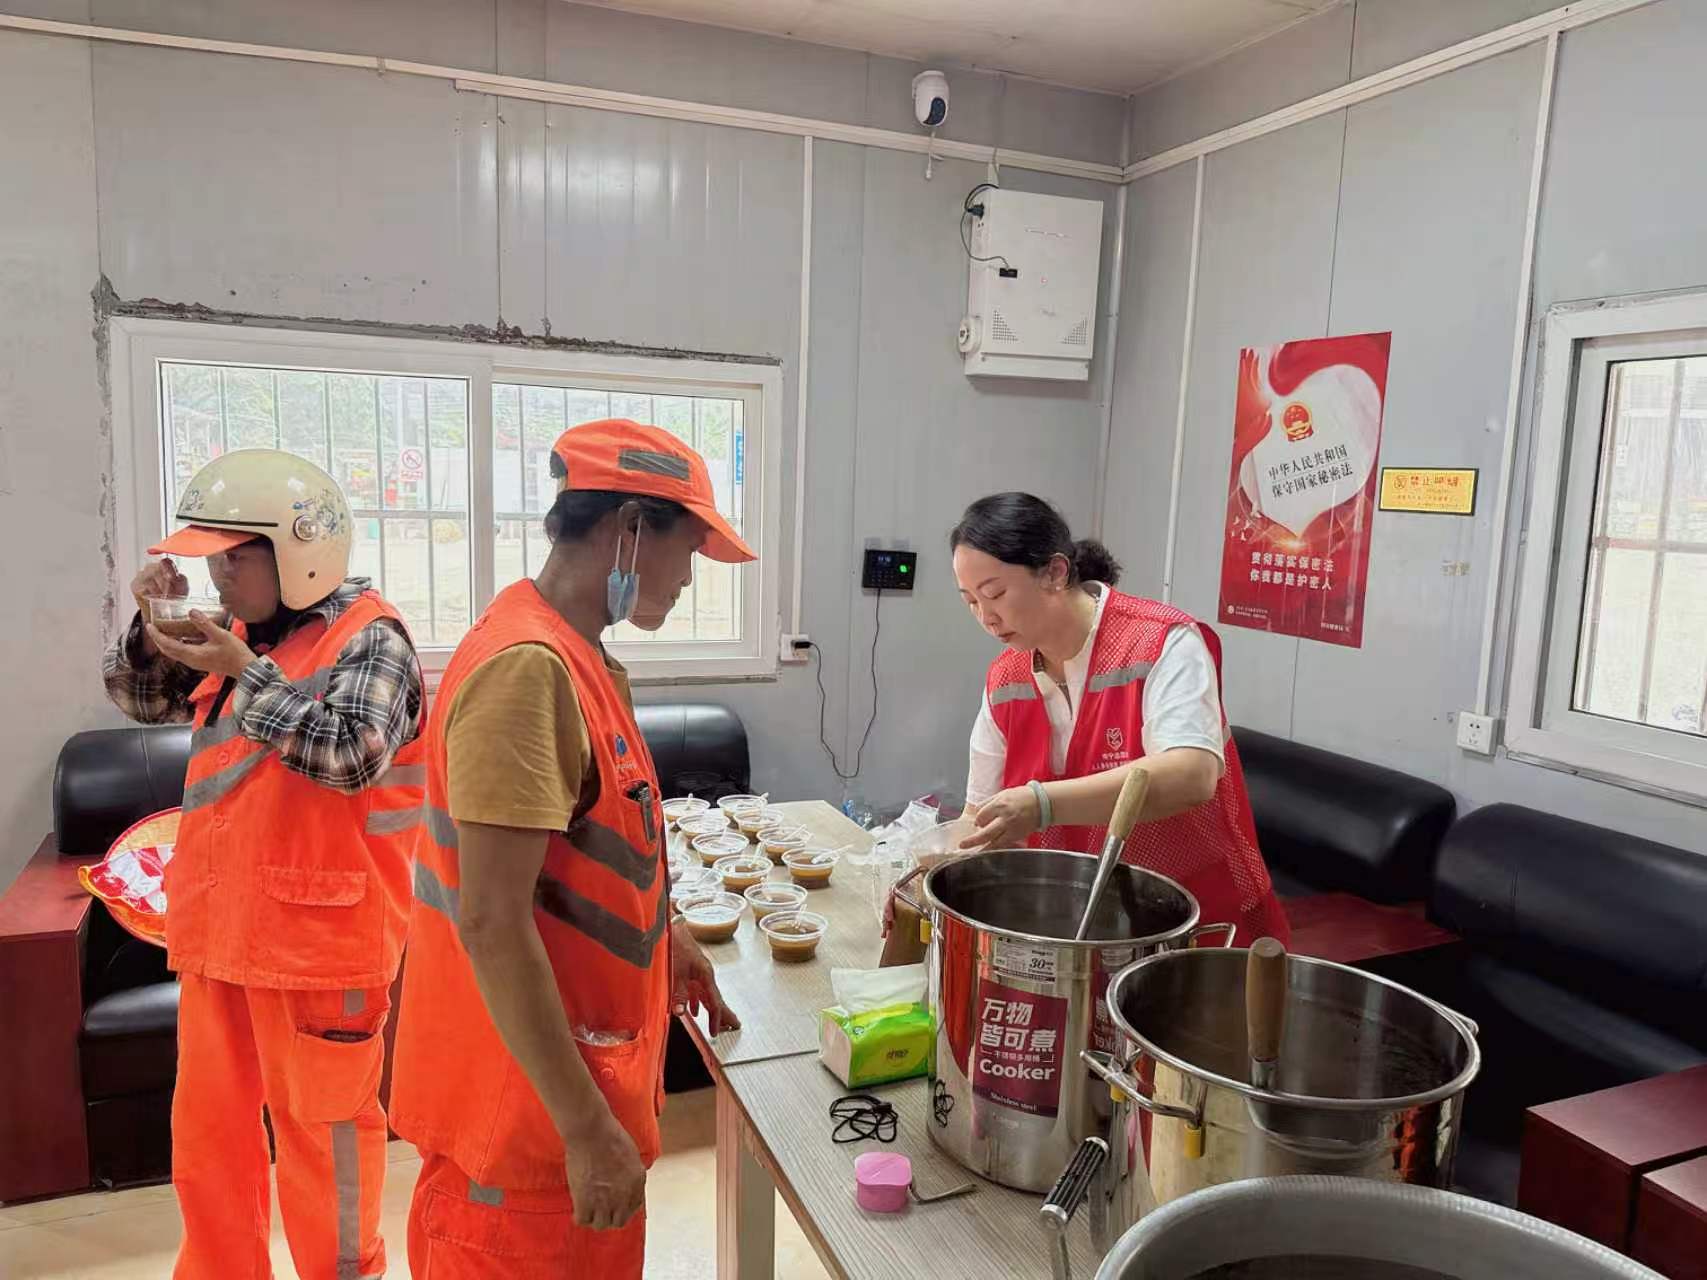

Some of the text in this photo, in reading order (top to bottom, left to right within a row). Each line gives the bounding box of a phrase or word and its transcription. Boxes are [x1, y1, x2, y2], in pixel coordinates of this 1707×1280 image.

[1268, 444, 1348, 480] 中华人民共和国
[1271, 462, 1353, 498] 保守国家秘密法
[982, 997, 1034, 1026] 万物
[980, 1024, 1057, 1053] 皆可煮
[979, 1059, 1056, 1081] Cooker
